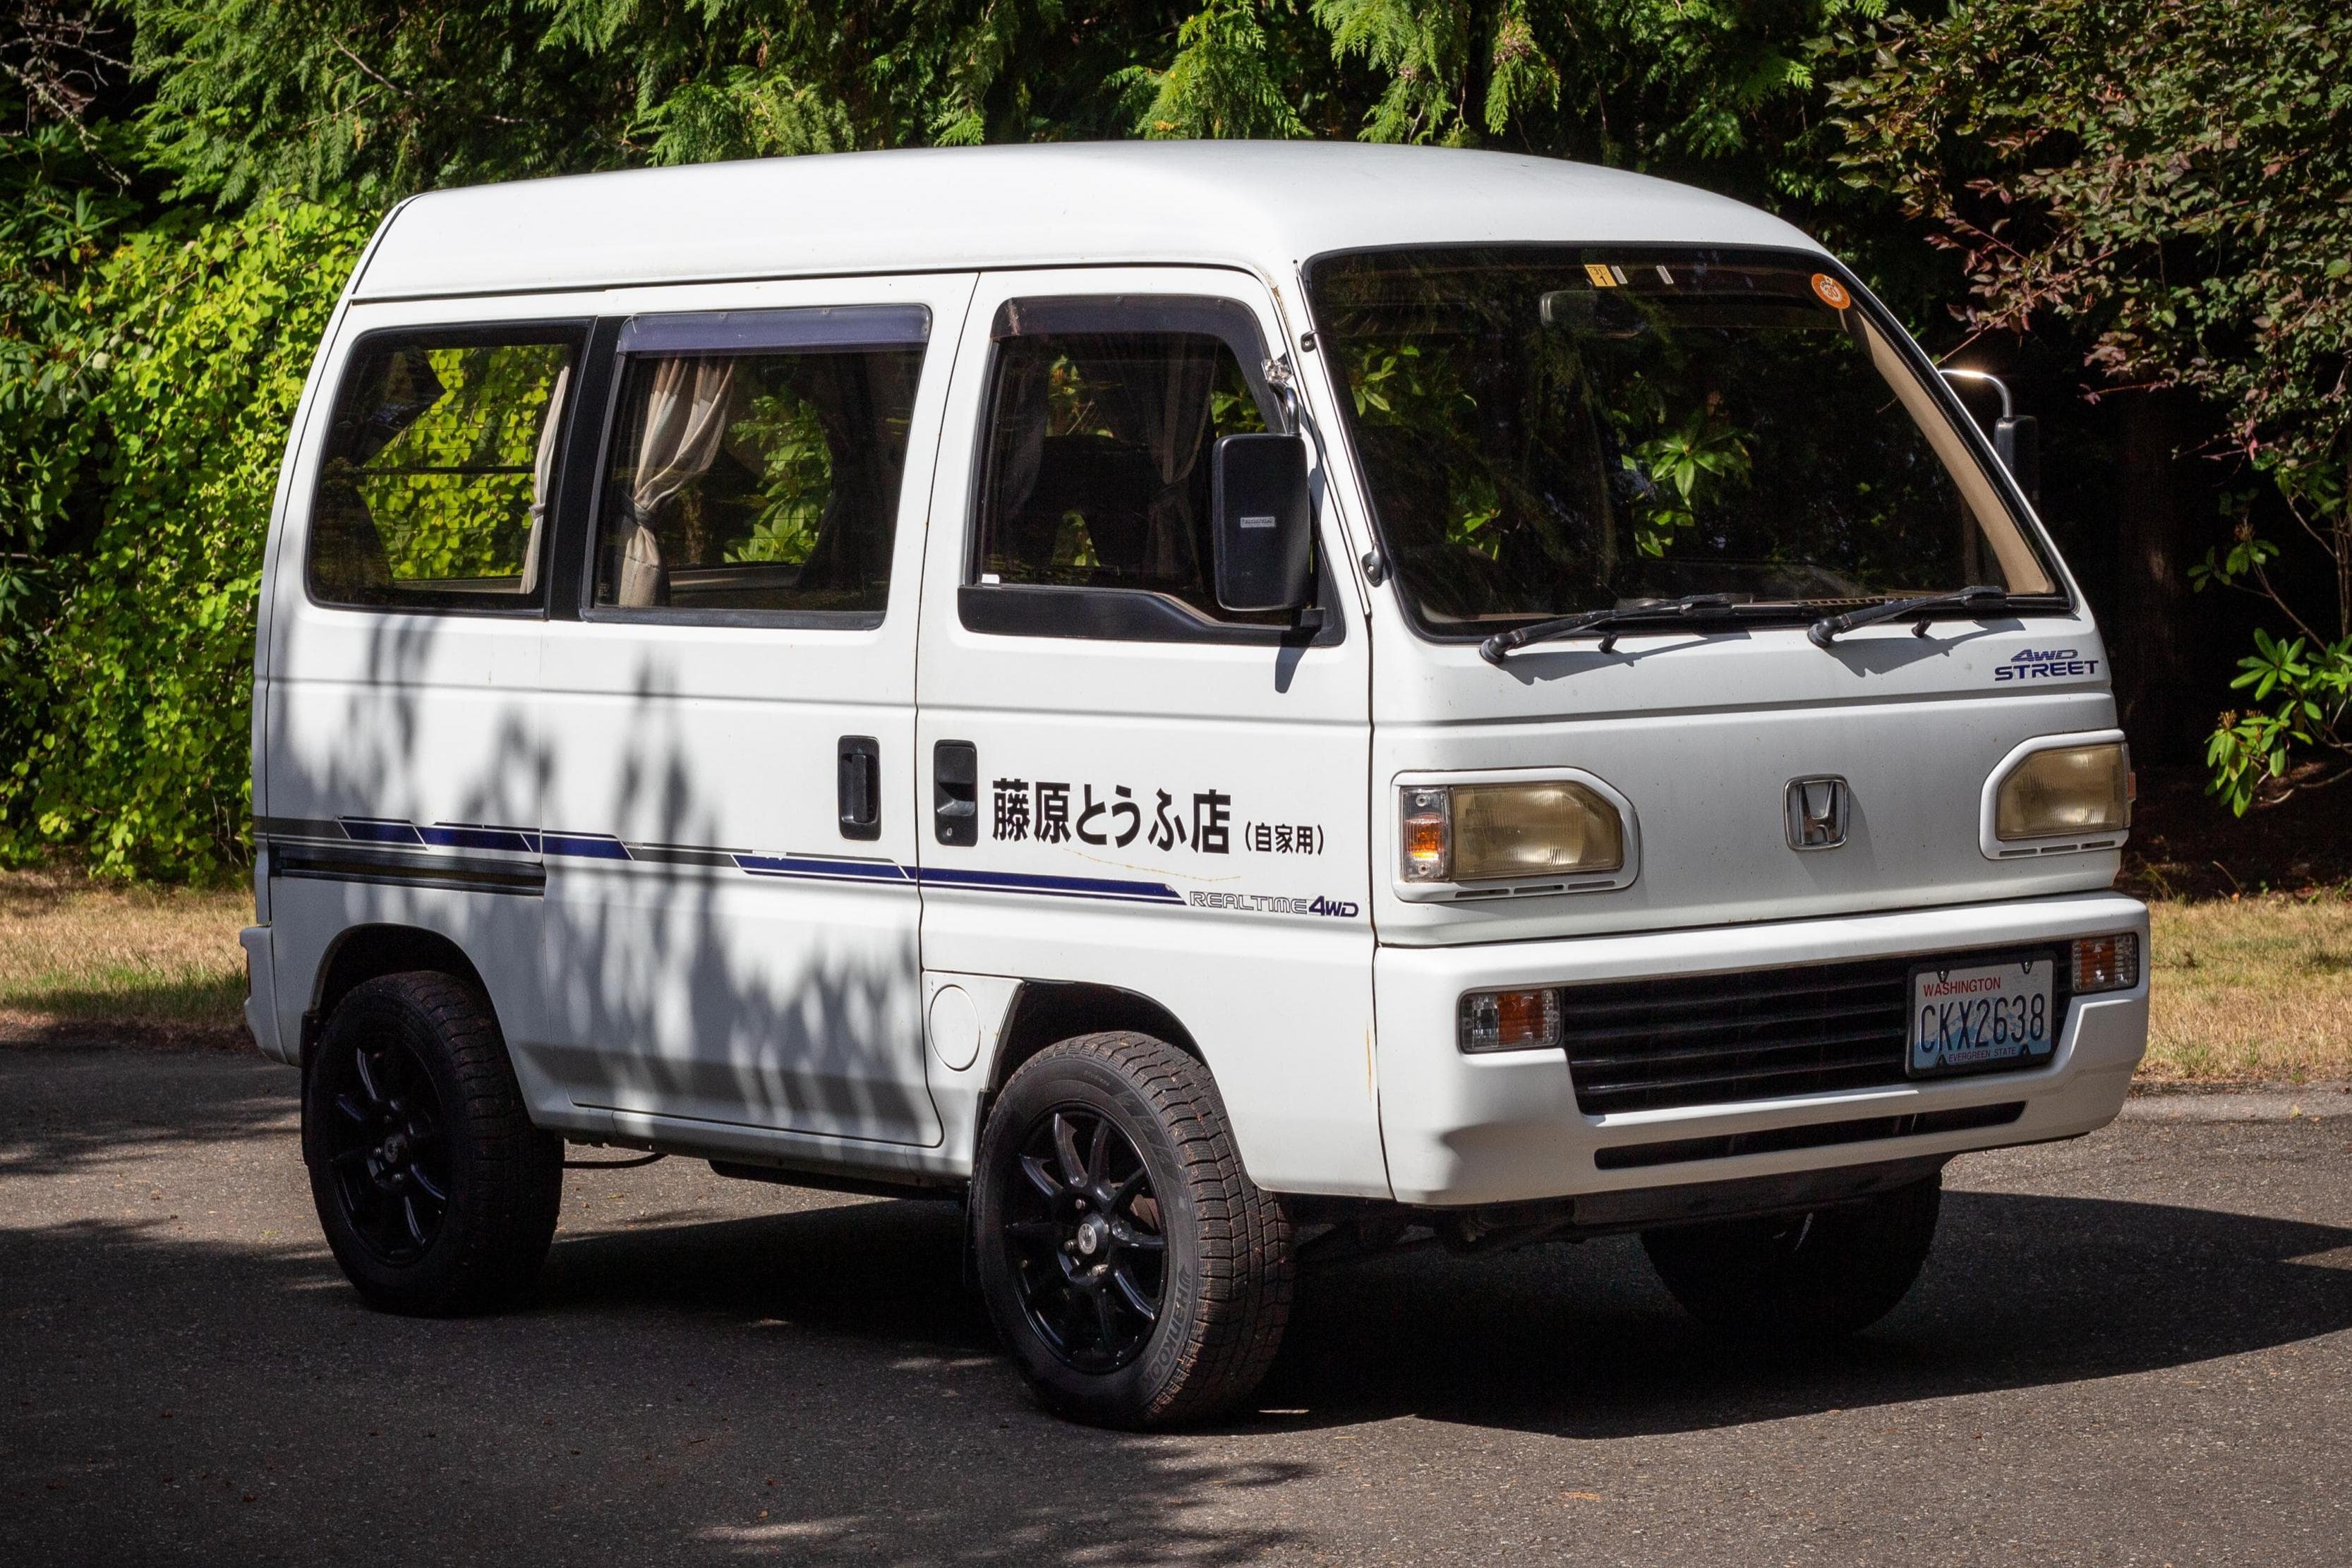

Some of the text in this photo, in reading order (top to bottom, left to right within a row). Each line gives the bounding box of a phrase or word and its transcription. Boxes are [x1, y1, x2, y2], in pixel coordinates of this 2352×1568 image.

[1994, 661, 2099, 681] STREET
[992, 778, 1231, 855] 藤原とうふ店
[1923, 977, 2001, 997] WASHINGTON
[1919, 993, 2045, 1053] CKX2638
[1948, 1047, 2017, 1062] EVERGREEN STATE
